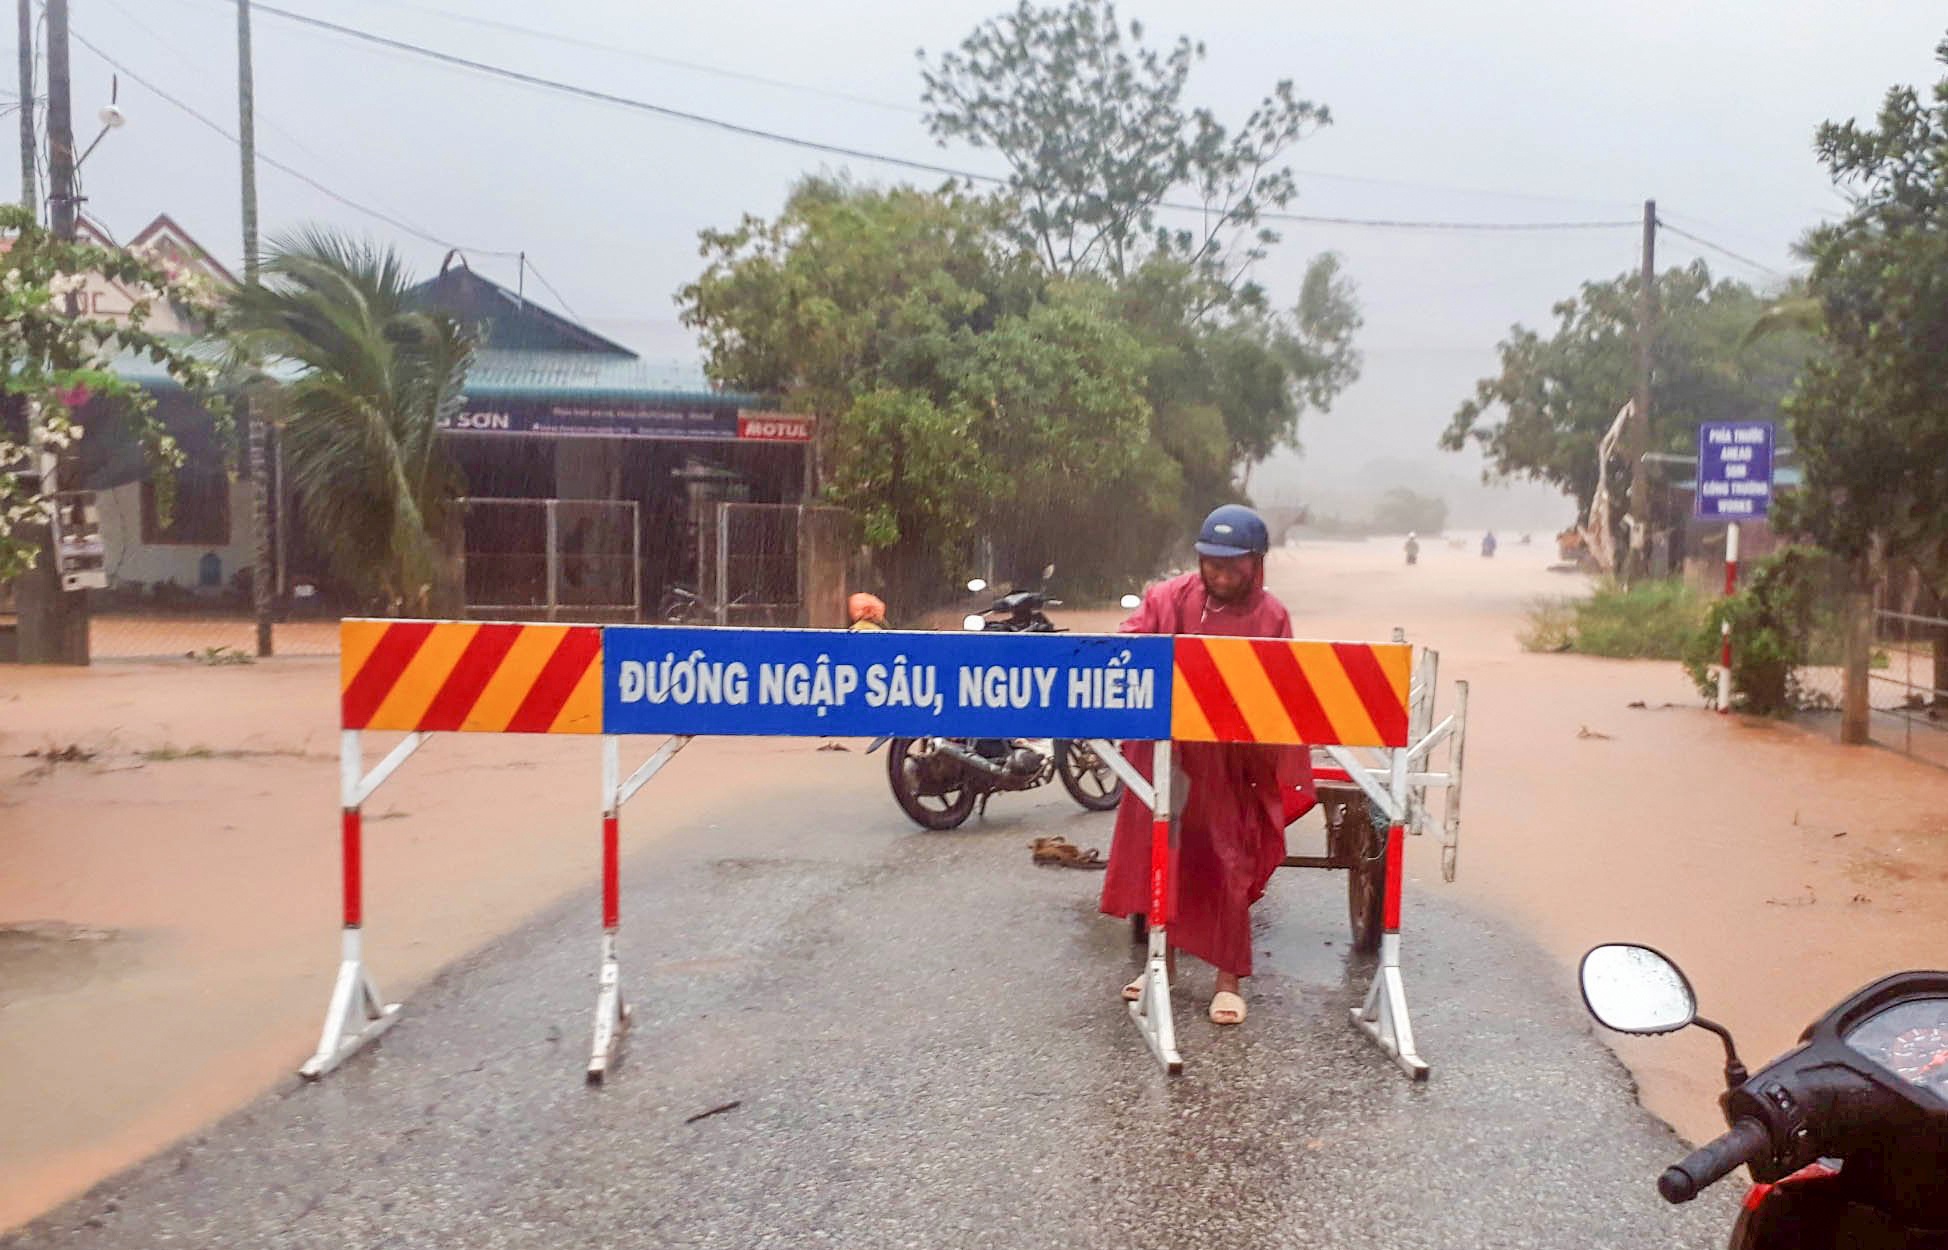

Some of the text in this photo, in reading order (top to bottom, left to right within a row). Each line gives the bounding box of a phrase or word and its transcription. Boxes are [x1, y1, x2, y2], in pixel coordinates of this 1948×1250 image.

[745, 421, 808, 437] MOTUL
[1721, 446, 1752, 462] AHEAD
[1717, 499, 1752, 513] WORKS
[618, 649, 1155, 717] ĐƯỜNG NGẬP SÂU, NGUY HIỂM
